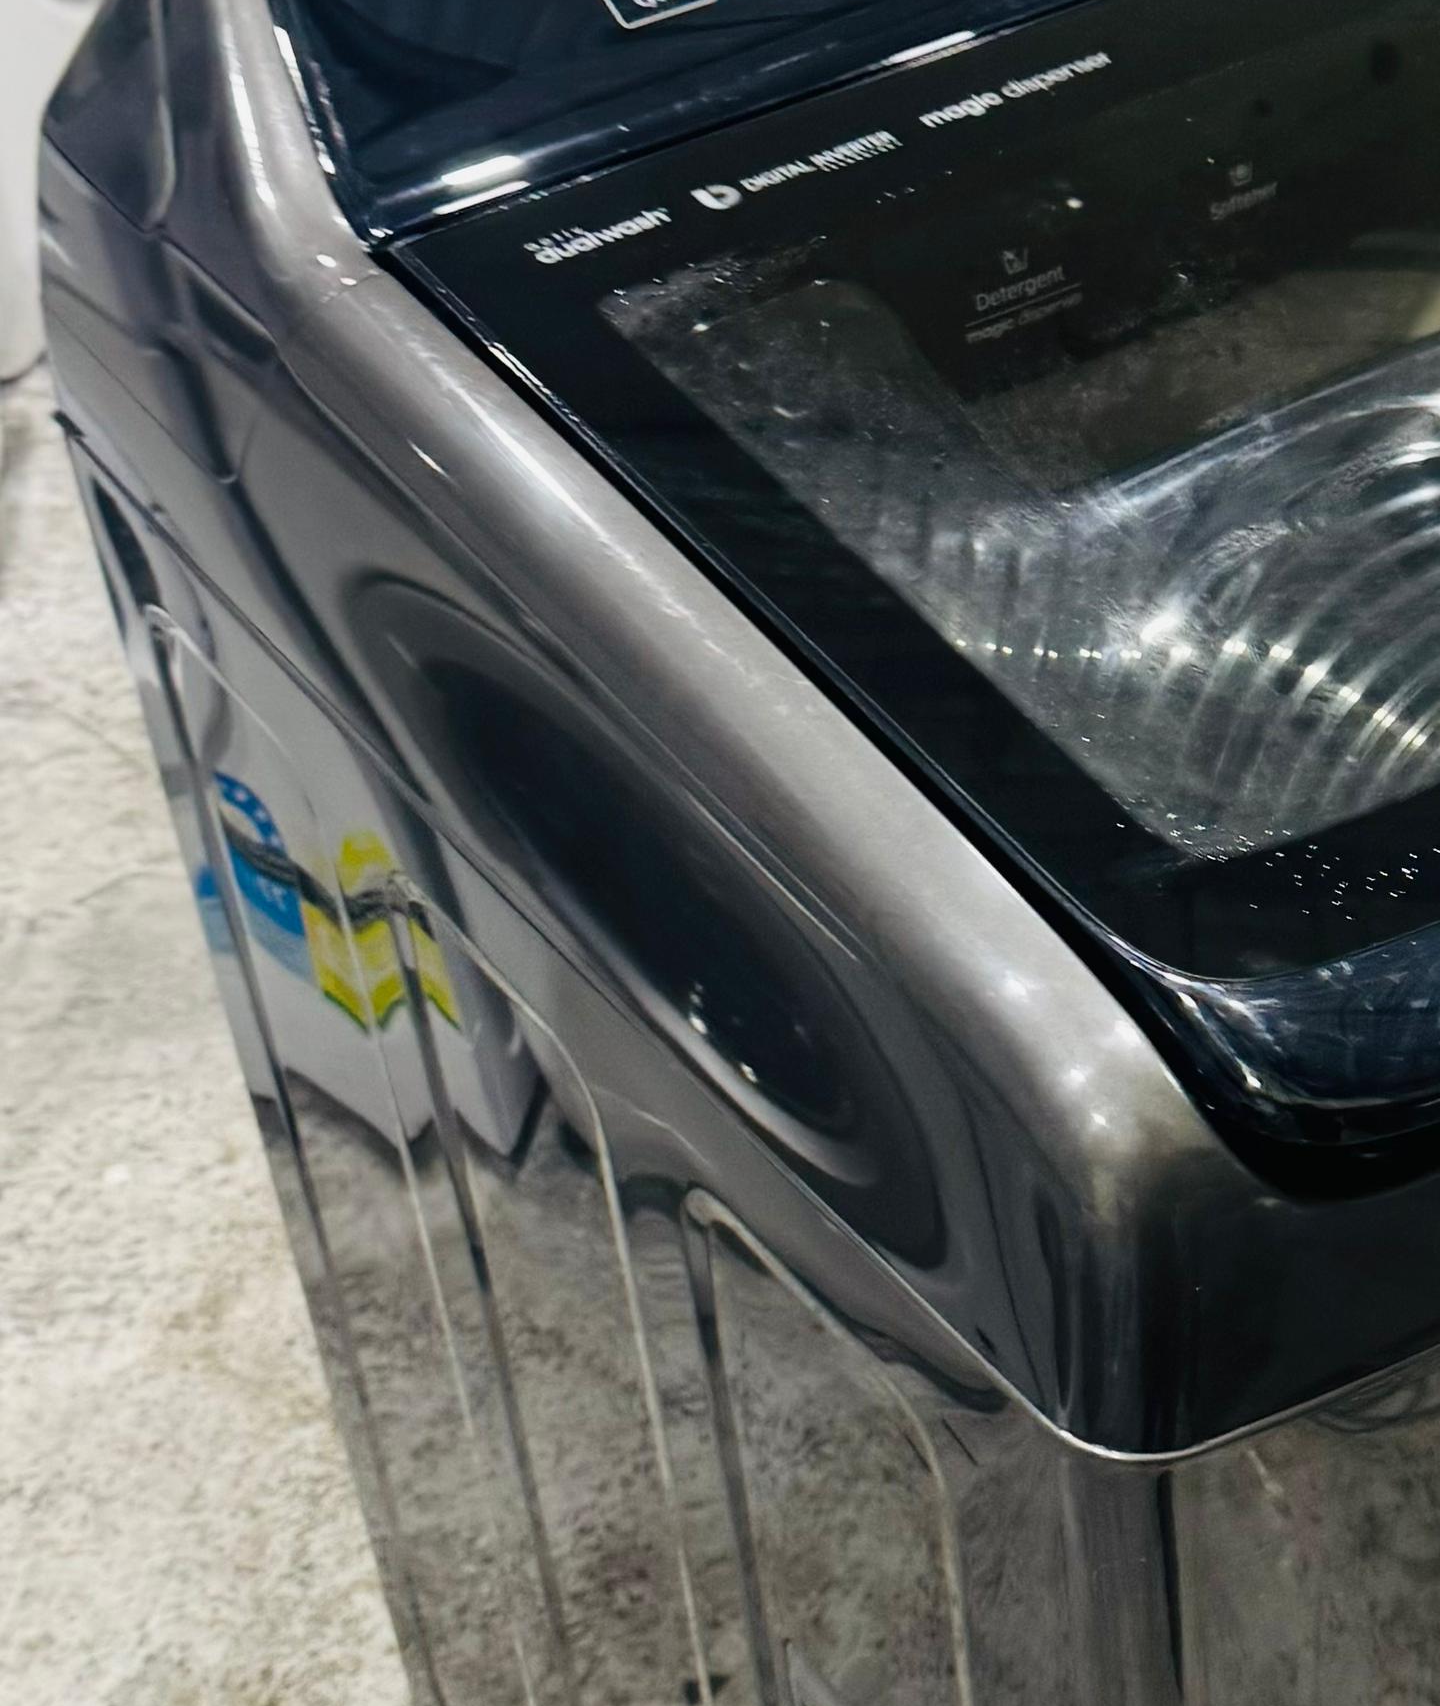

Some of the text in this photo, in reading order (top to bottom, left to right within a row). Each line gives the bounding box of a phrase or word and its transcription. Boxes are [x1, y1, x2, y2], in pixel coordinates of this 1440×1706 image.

[918, 51, 1112, 129] magic dispenser
[739, 129, 903, 192] DIGITAL INVERTER
[534, 209, 672, 264] dualwash
[975, 263, 1067, 312] Detergent
